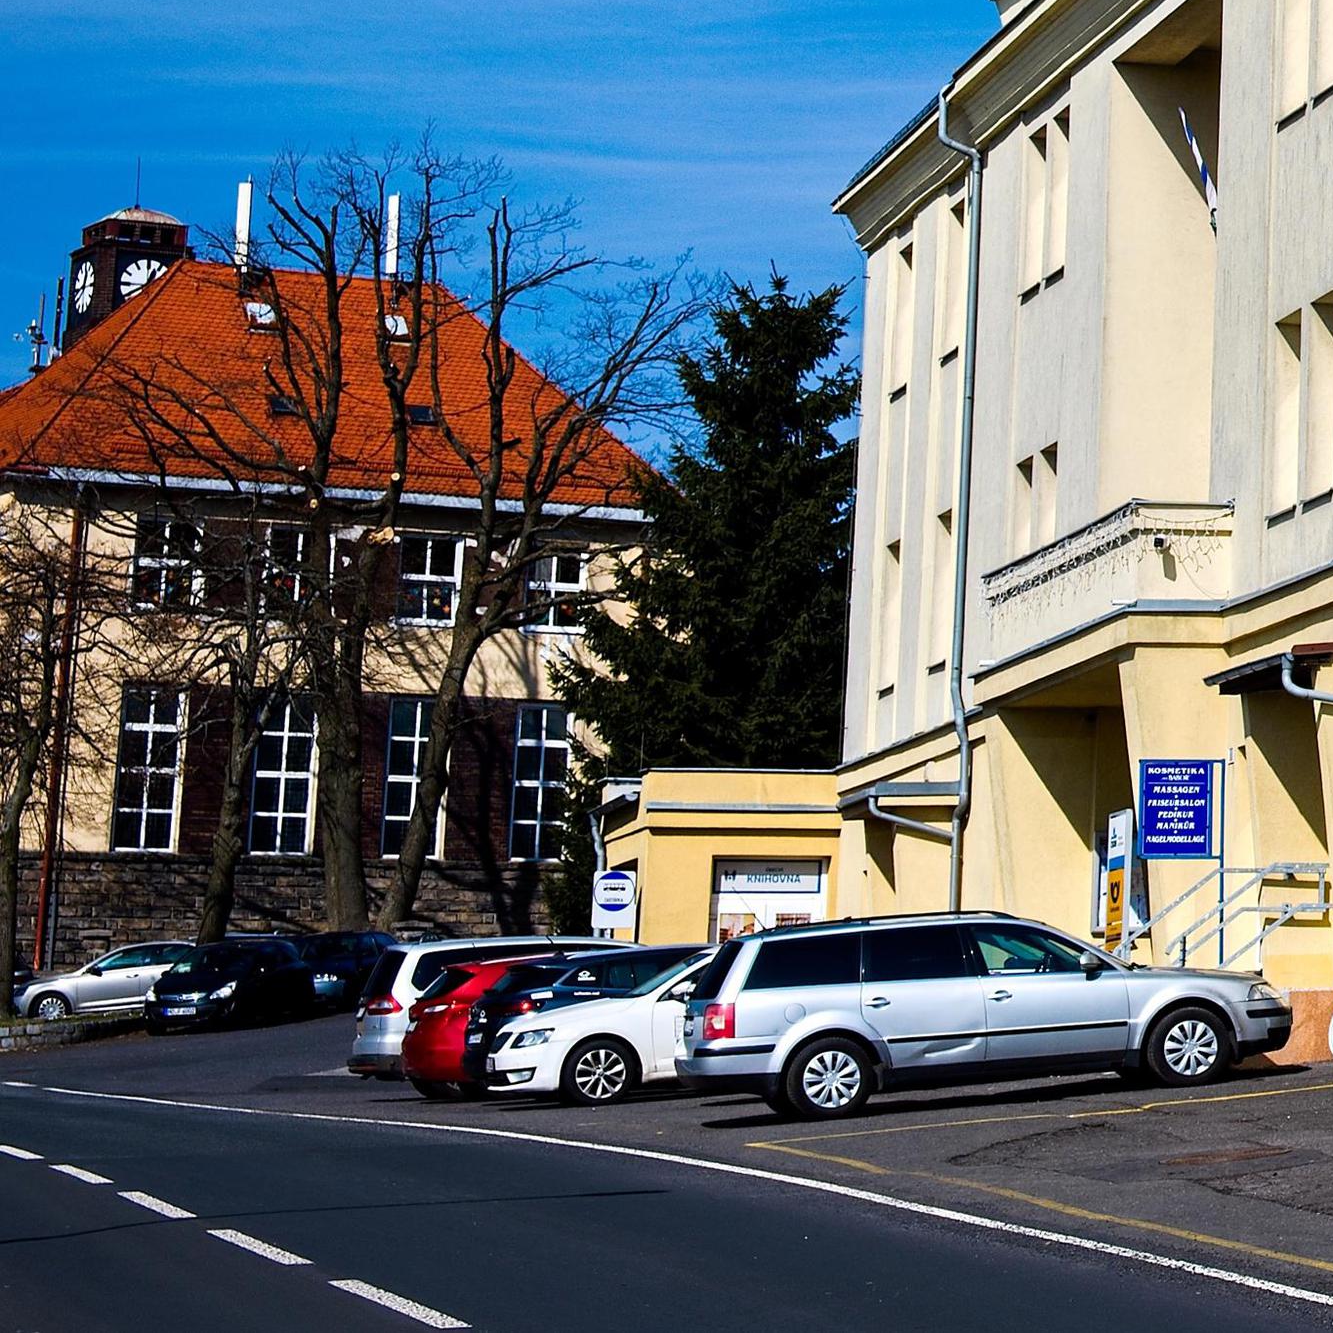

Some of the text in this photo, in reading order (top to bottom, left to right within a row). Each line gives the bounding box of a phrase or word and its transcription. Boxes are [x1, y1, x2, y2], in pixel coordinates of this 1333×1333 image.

[1148, 767, 1205, 775] KOSMETIKA
[1153, 785, 1200, 794] MASSAGEN
[1147, 799, 1205, 807] FRISEURSALON
[747, 874, 801, 883] KNIHOVNA
